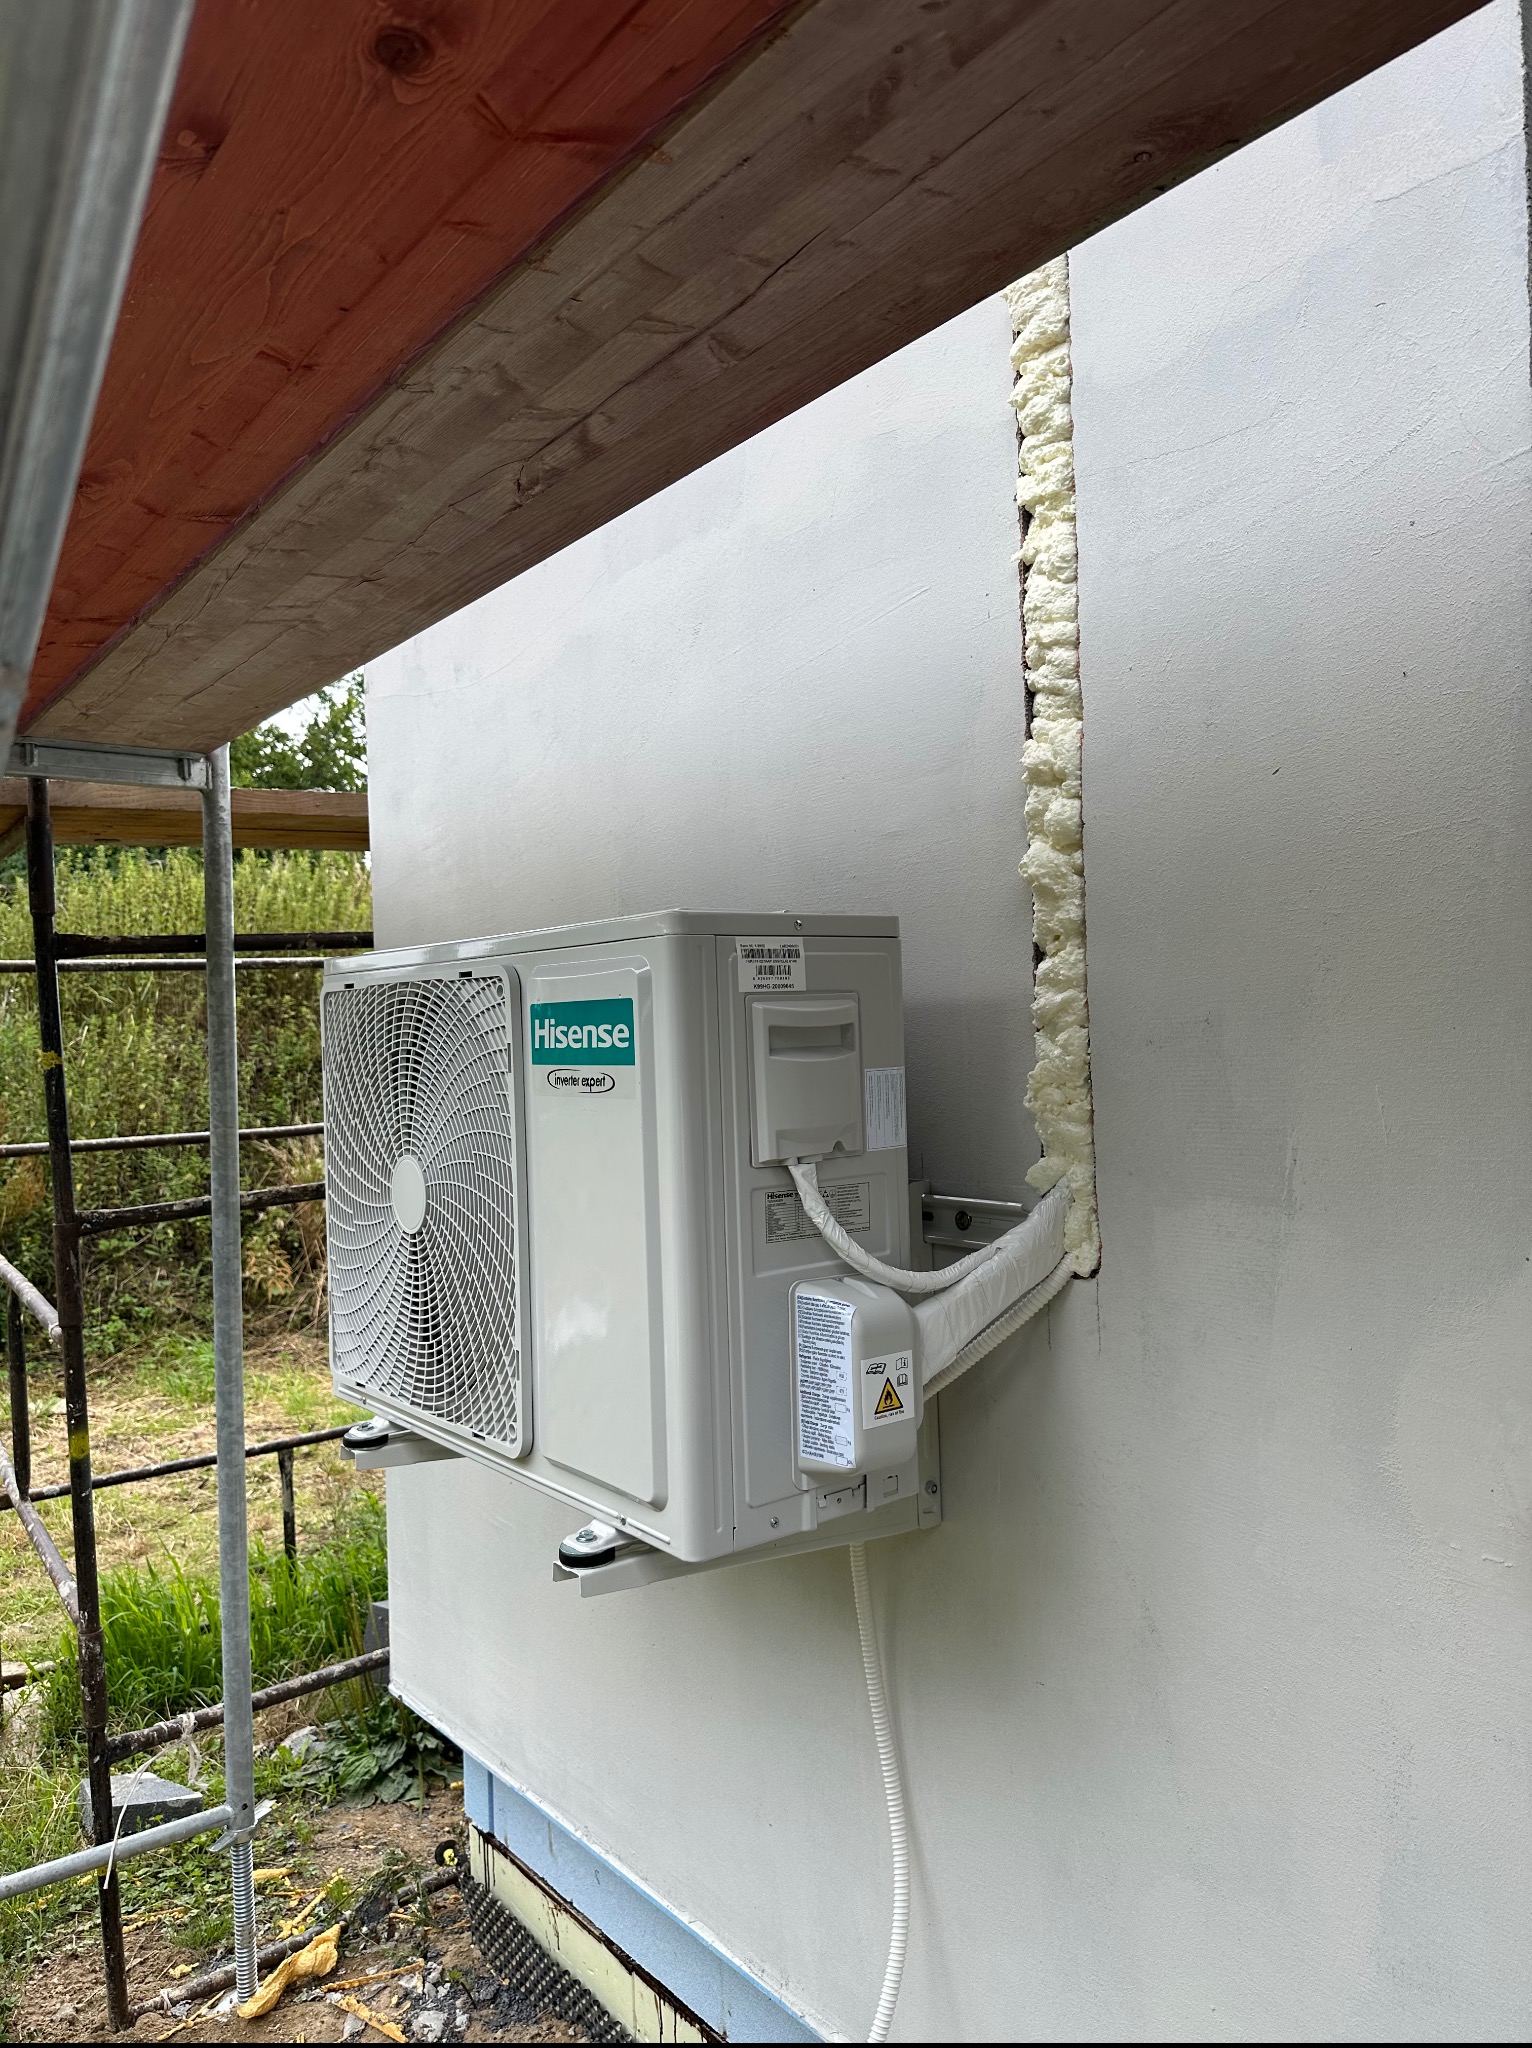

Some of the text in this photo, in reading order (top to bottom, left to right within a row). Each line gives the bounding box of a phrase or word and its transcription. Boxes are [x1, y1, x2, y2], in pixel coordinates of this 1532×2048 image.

[534, 1018, 630, 1049] Hisense
[554, 1073, 606, 1092] inverter expert
[766, 1192, 794, 1200] Hisense
